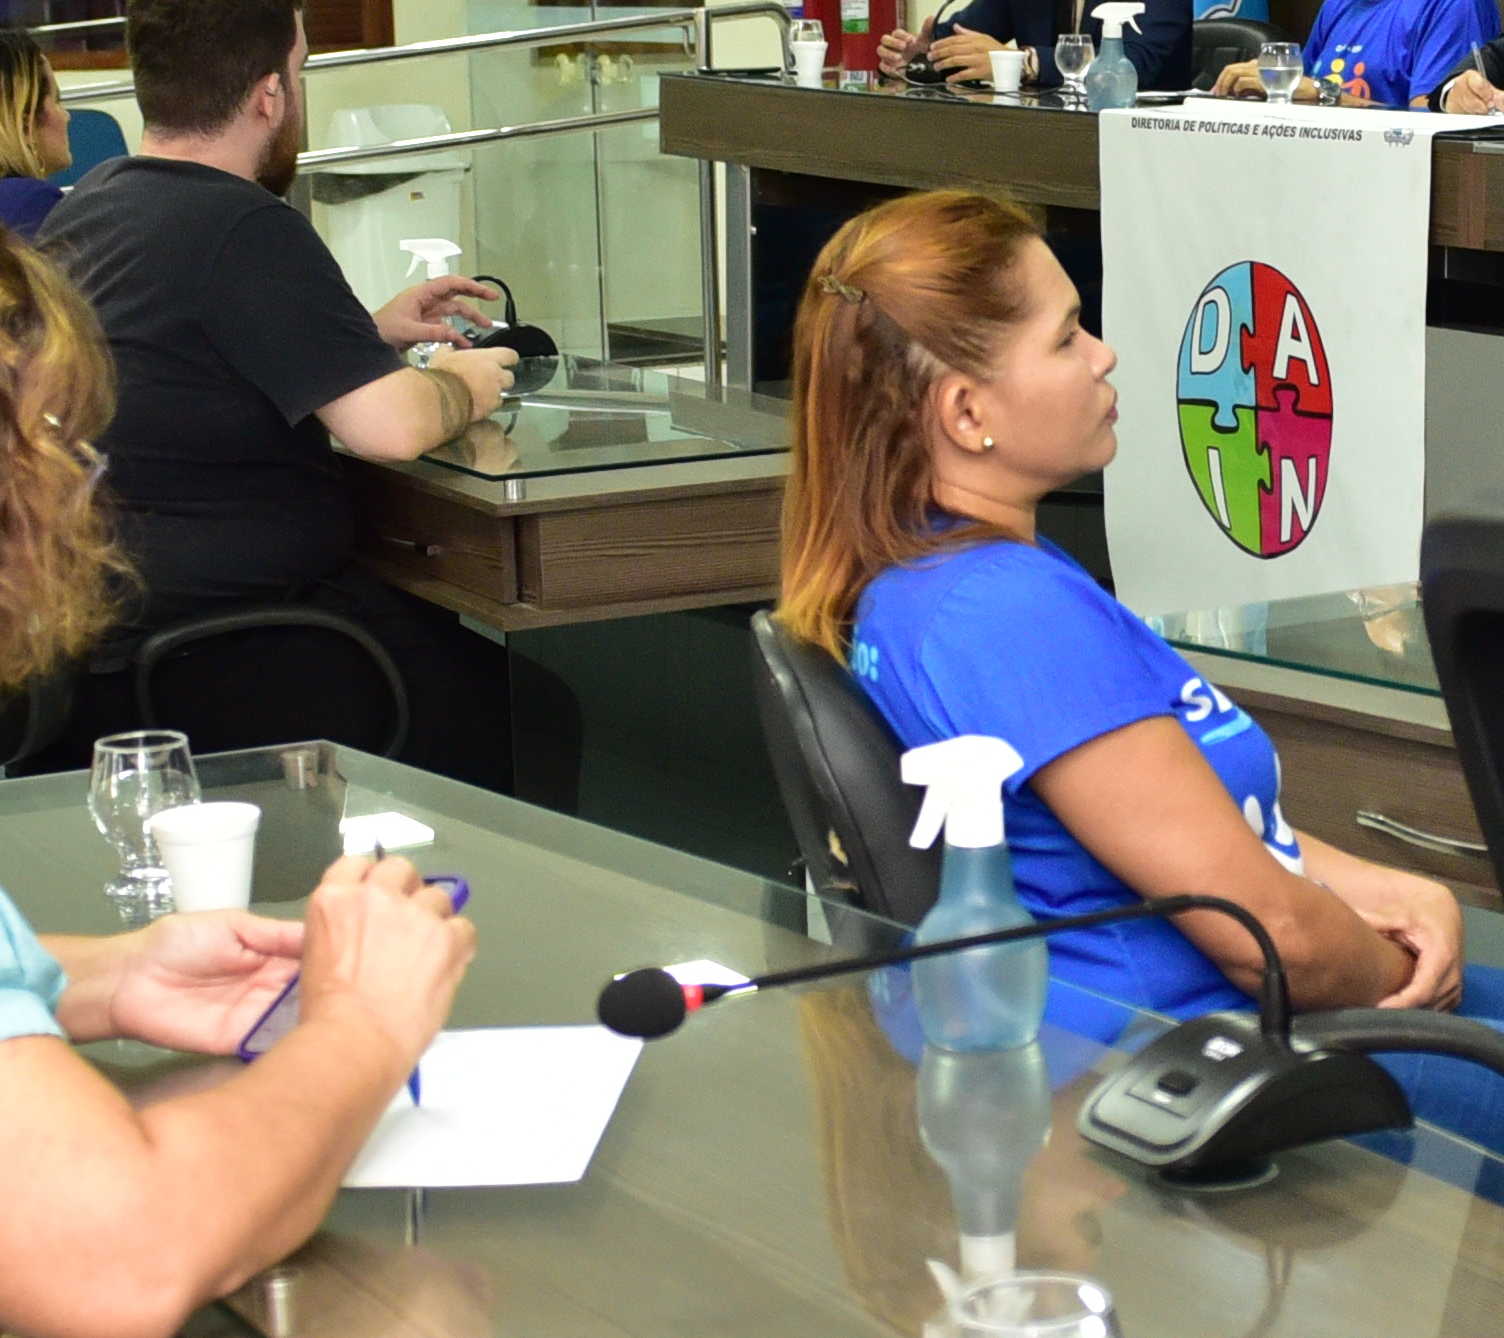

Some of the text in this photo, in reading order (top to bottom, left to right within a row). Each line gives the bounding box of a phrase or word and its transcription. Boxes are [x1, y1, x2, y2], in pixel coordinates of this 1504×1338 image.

[1131, 117, 1181, 131] DIRETORIA
[1183, 119, 1196, 132] DE
[1198, 119, 1251, 135] POLÍTICAS
[1252, 124, 1261, 136] E
[1299, 126, 1363, 142] INCLUSIVAS
